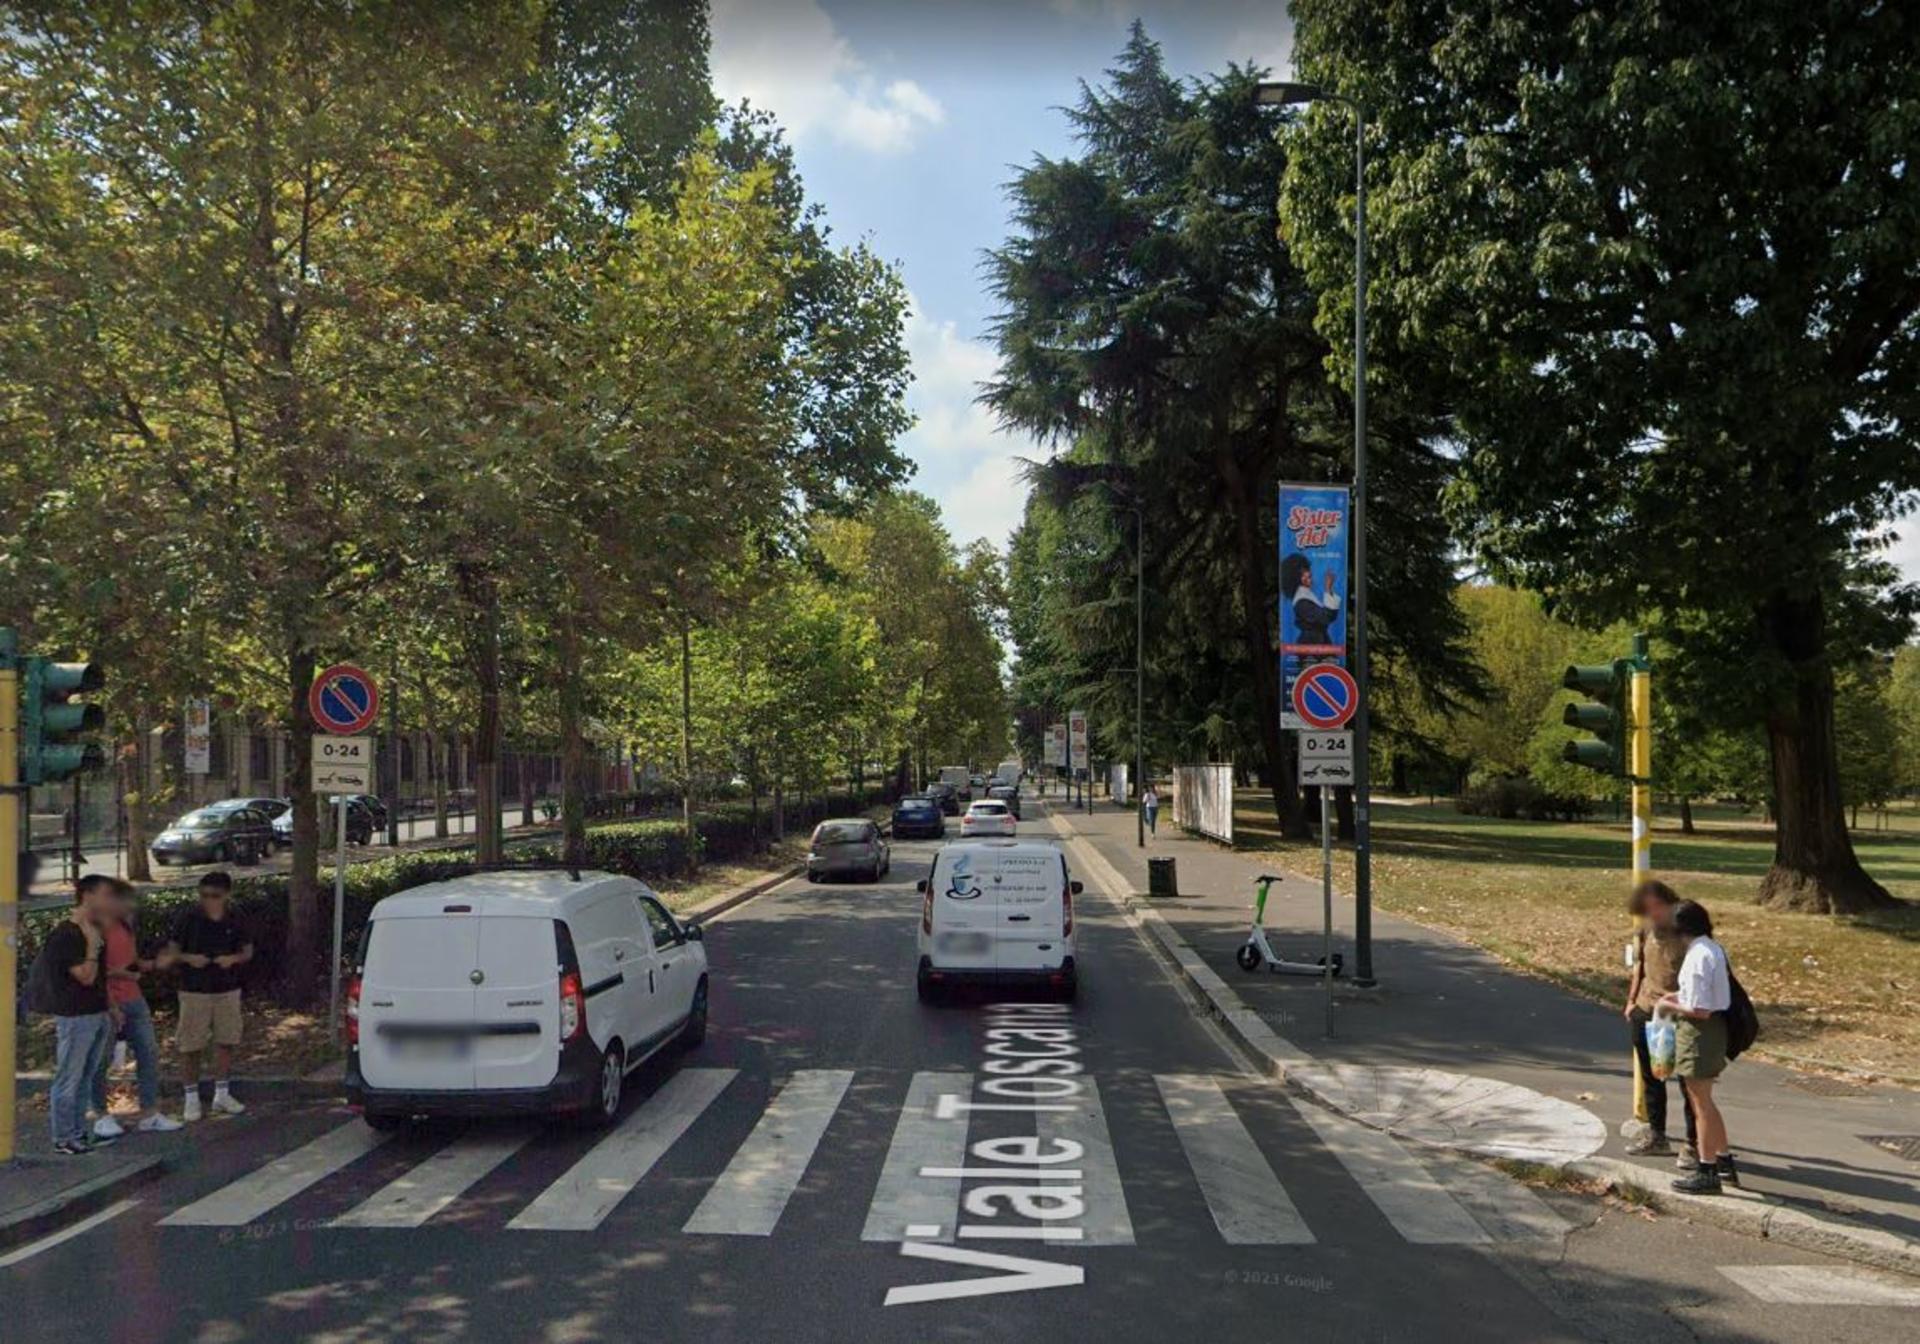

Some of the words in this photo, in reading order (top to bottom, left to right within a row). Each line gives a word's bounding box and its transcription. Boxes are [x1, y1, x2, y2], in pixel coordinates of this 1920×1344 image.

[1288, 506, 1341, 529] Sister
[1297, 526, 1328, 549] Act
[323, 744, 359, 757] 0-24
